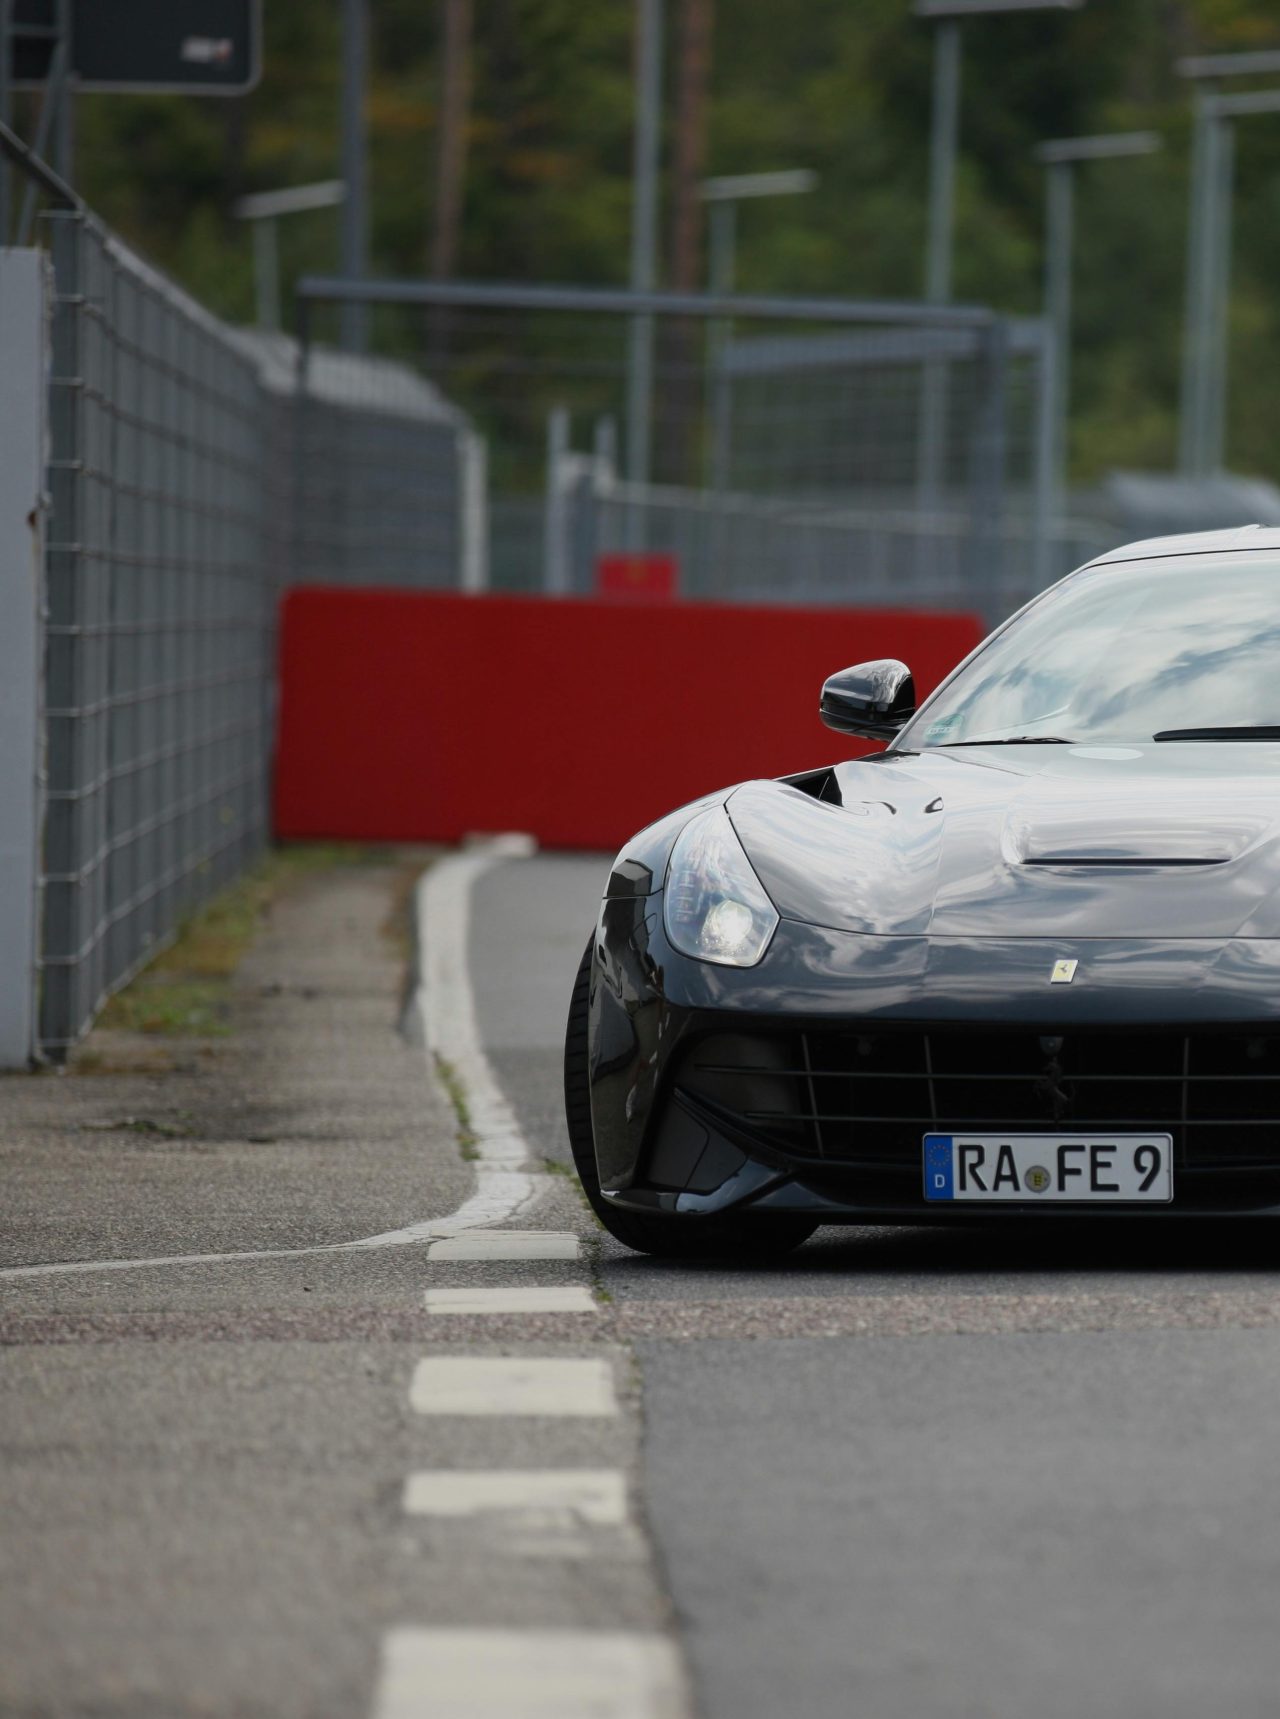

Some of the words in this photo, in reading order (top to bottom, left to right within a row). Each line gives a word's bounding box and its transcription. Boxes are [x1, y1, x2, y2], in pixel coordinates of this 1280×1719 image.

[935, 1174, 945, 1188] D
[959, 1145, 1020, 1191] RA
[1057, 1145, 1120, 1192] FE
[1133, 1145, 1162, 1192] 9
